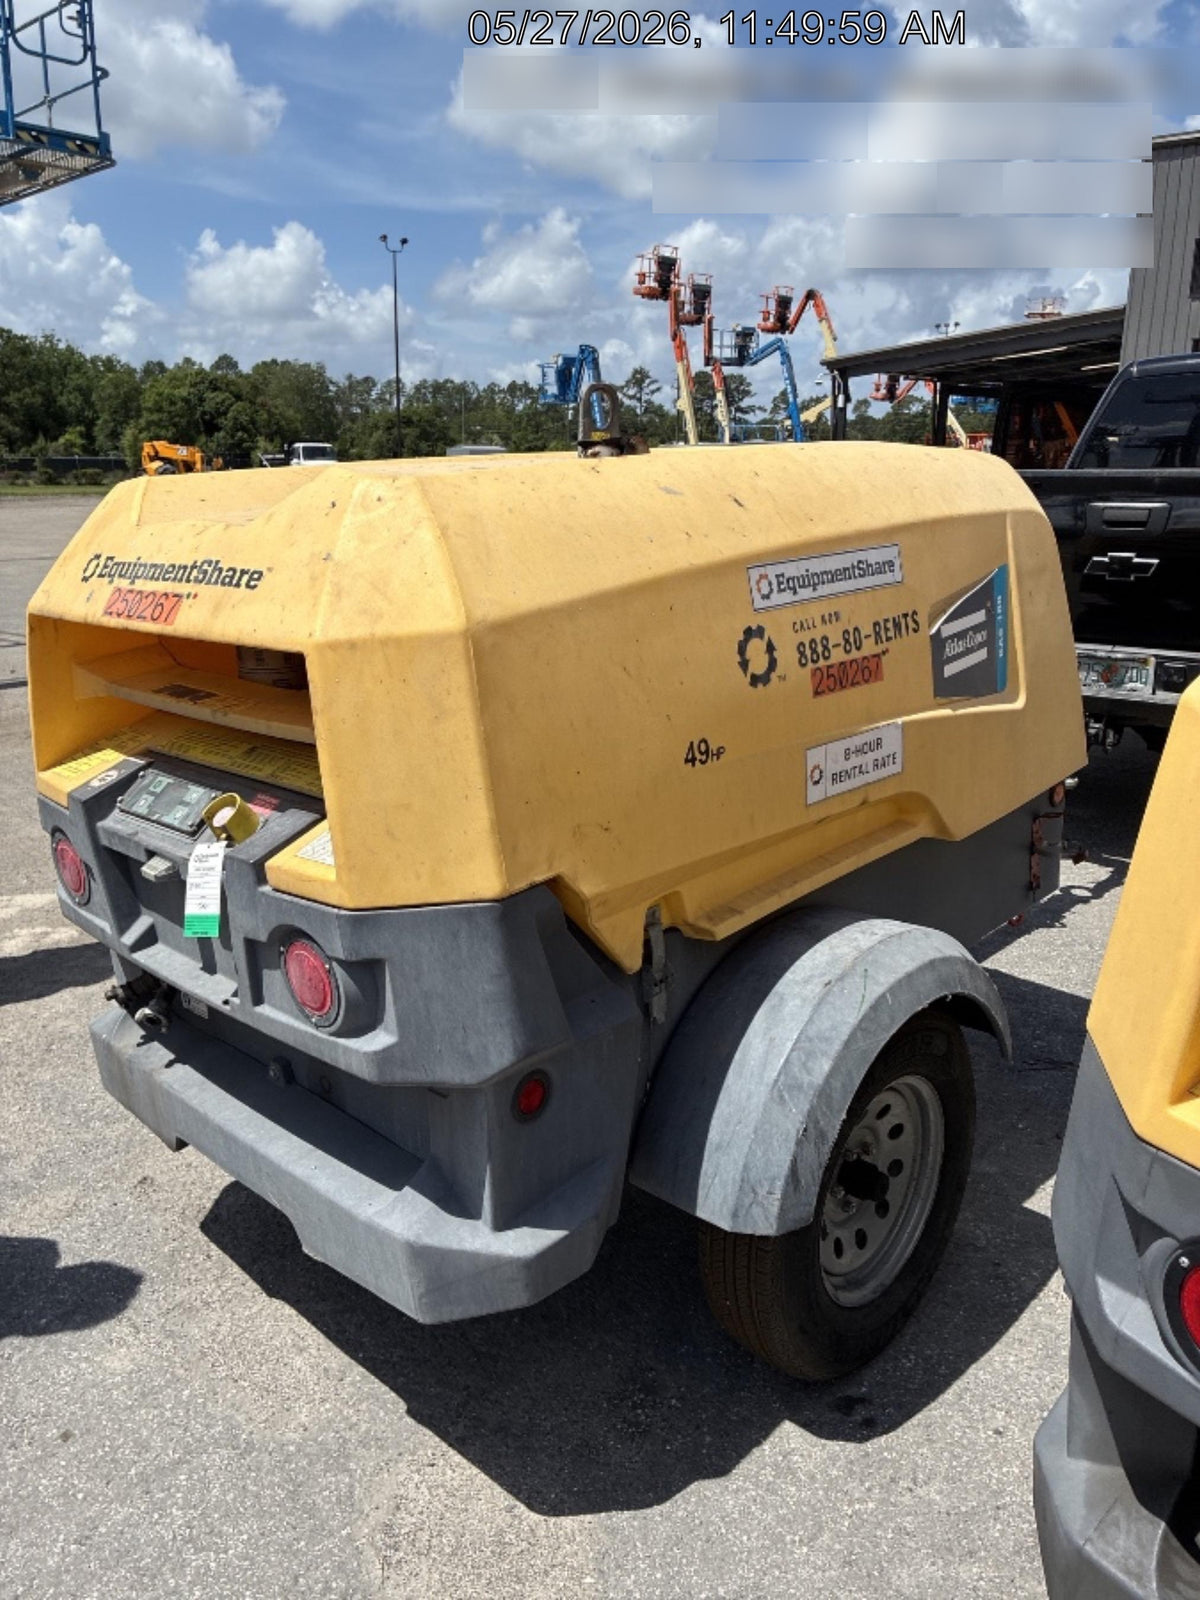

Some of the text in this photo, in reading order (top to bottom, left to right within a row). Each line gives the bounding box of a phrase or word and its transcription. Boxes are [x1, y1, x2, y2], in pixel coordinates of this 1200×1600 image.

[97, 555, 263, 589] EquipmentShare
[776, 558, 896, 595] EquipmentShare
[104, 587, 183, 623] 250267
[792, 616, 817, 634] CALL
[797, 610, 920, 668] 888-80-RENTS
[813, 655, 882, 695] 250267
[844, 737, 883, 761] 8-HOUR
[831, 752, 897, 786] RENTAL RATE
